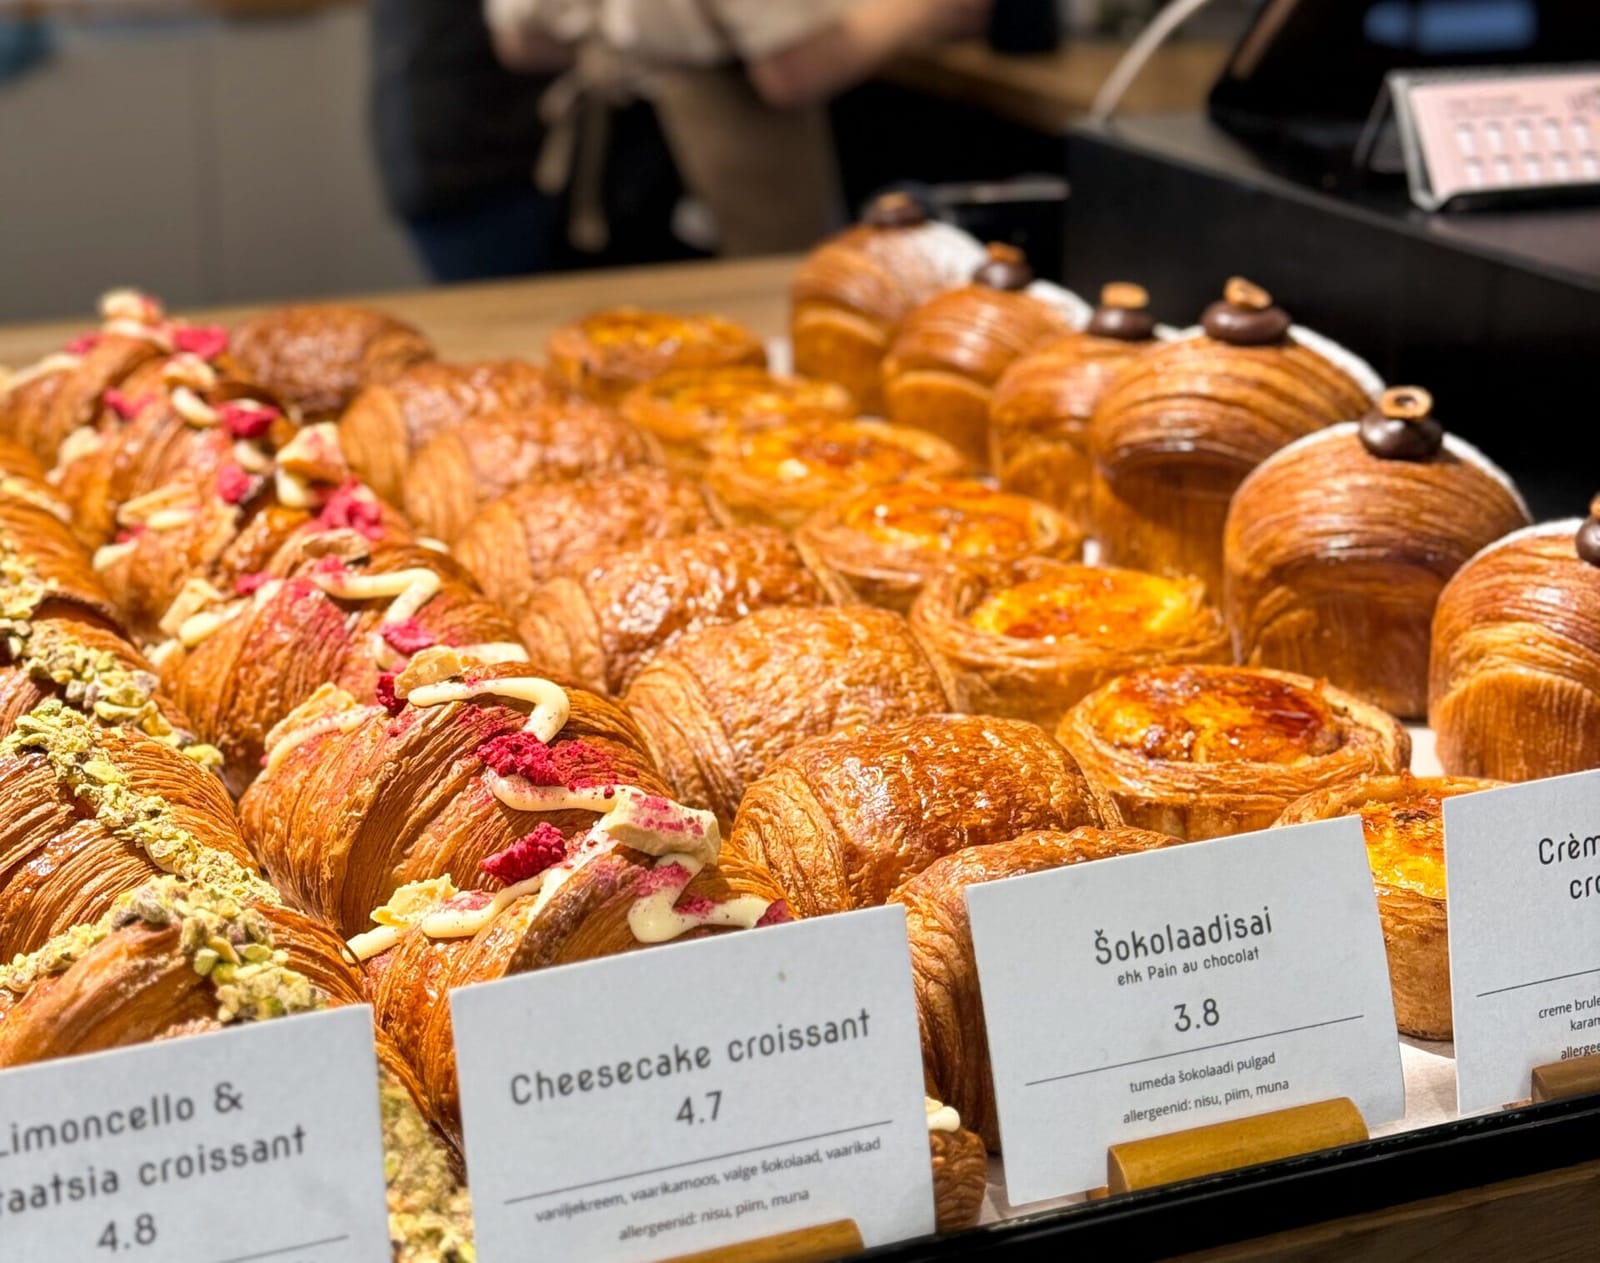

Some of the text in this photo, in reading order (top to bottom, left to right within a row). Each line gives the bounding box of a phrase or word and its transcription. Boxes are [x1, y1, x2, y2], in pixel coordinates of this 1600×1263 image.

[1538, 832, 1600, 865] Crèm
[1094, 905, 1272, 965] Šokolaadisai
[1117, 946, 1259, 986] ehk Pain au chocolat
[1173, 998, 1220, 1032] 3.8
[1538, 1003, 1572, 1019] creme
[511, 1007, 870, 1106] Cheesecake croissant
[1129, 1051, 1276, 1094] tumeda šokolaadi pulgad
[214, 1081, 243, 1114] &
[675, 1089, 722, 1126] 4.7
[1123, 1079, 1289, 1125] allergeenid: nisu, piim, muna
[0, 1124, 307, 1216] aatsia croissant
[535, 1136, 881, 1223] vaniljekreem, vaarikamoos, valge šokolaad, vaarikad
[97, 1213, 157, 1253] 4.8
[618, 1189, 810, 1241] allergeenid: nisu, piim, muna
